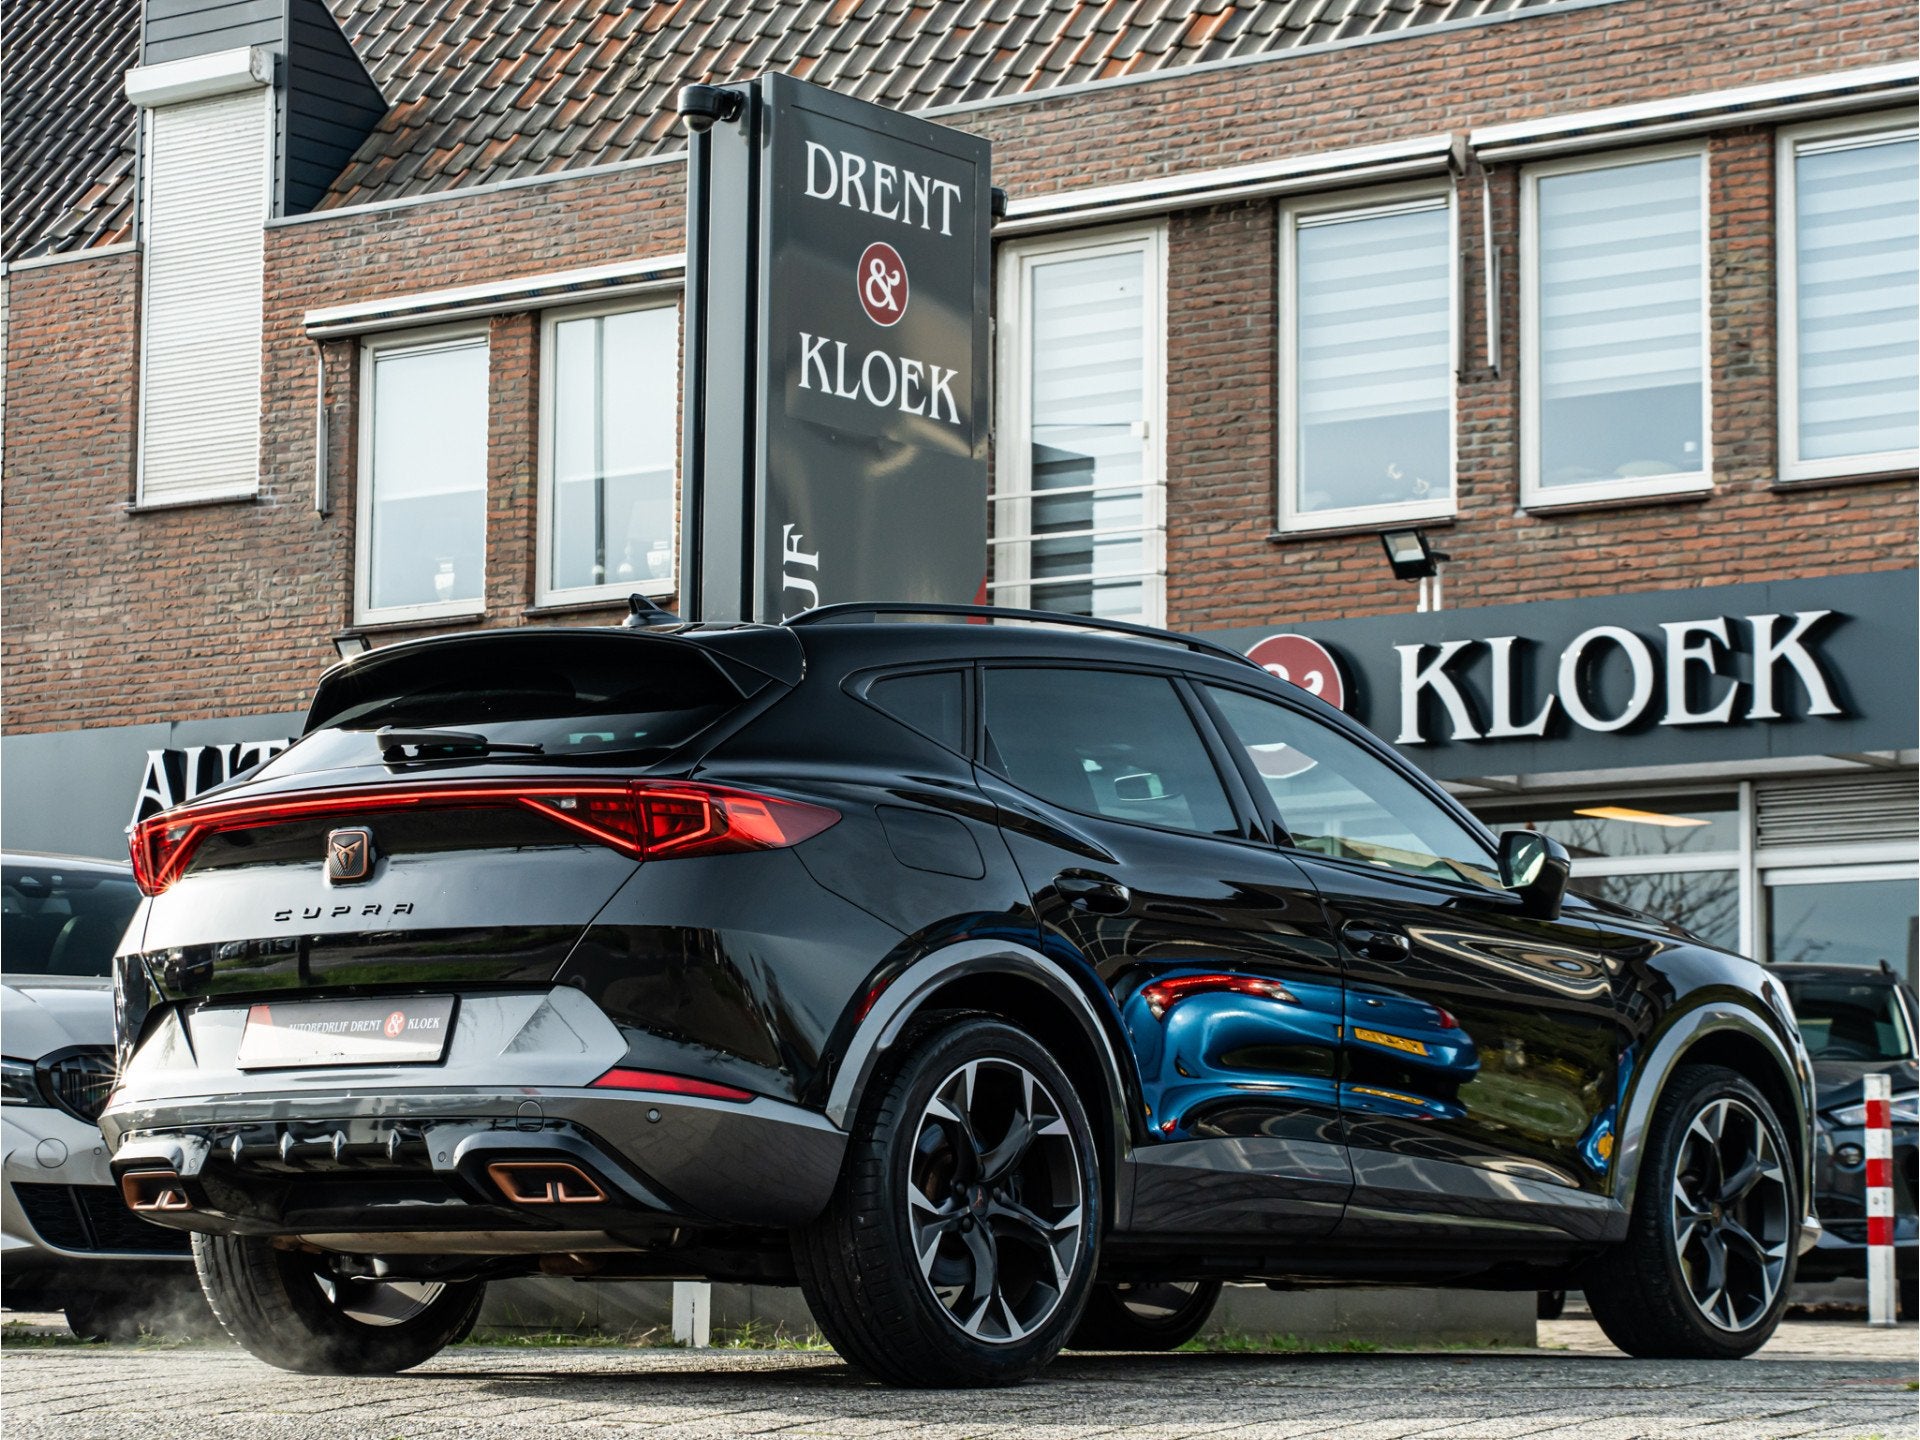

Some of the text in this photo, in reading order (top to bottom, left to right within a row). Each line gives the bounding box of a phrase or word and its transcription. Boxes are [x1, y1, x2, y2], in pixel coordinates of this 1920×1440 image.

[804, 140, 961, 236] DRENT
[864, 257, 901, 312] &
[798, 331, 961, 425] KLOEK
[782, 523, 819, 622] JF
[1394, 610, 1842, 744] KLOEK
[273, 902, 414, 921] CUPRA
[350, 1020, 382, 1032] DRENT
[387, 1014, 404, 1034] &
[407, 1017, 440, 1029] KLOEK
